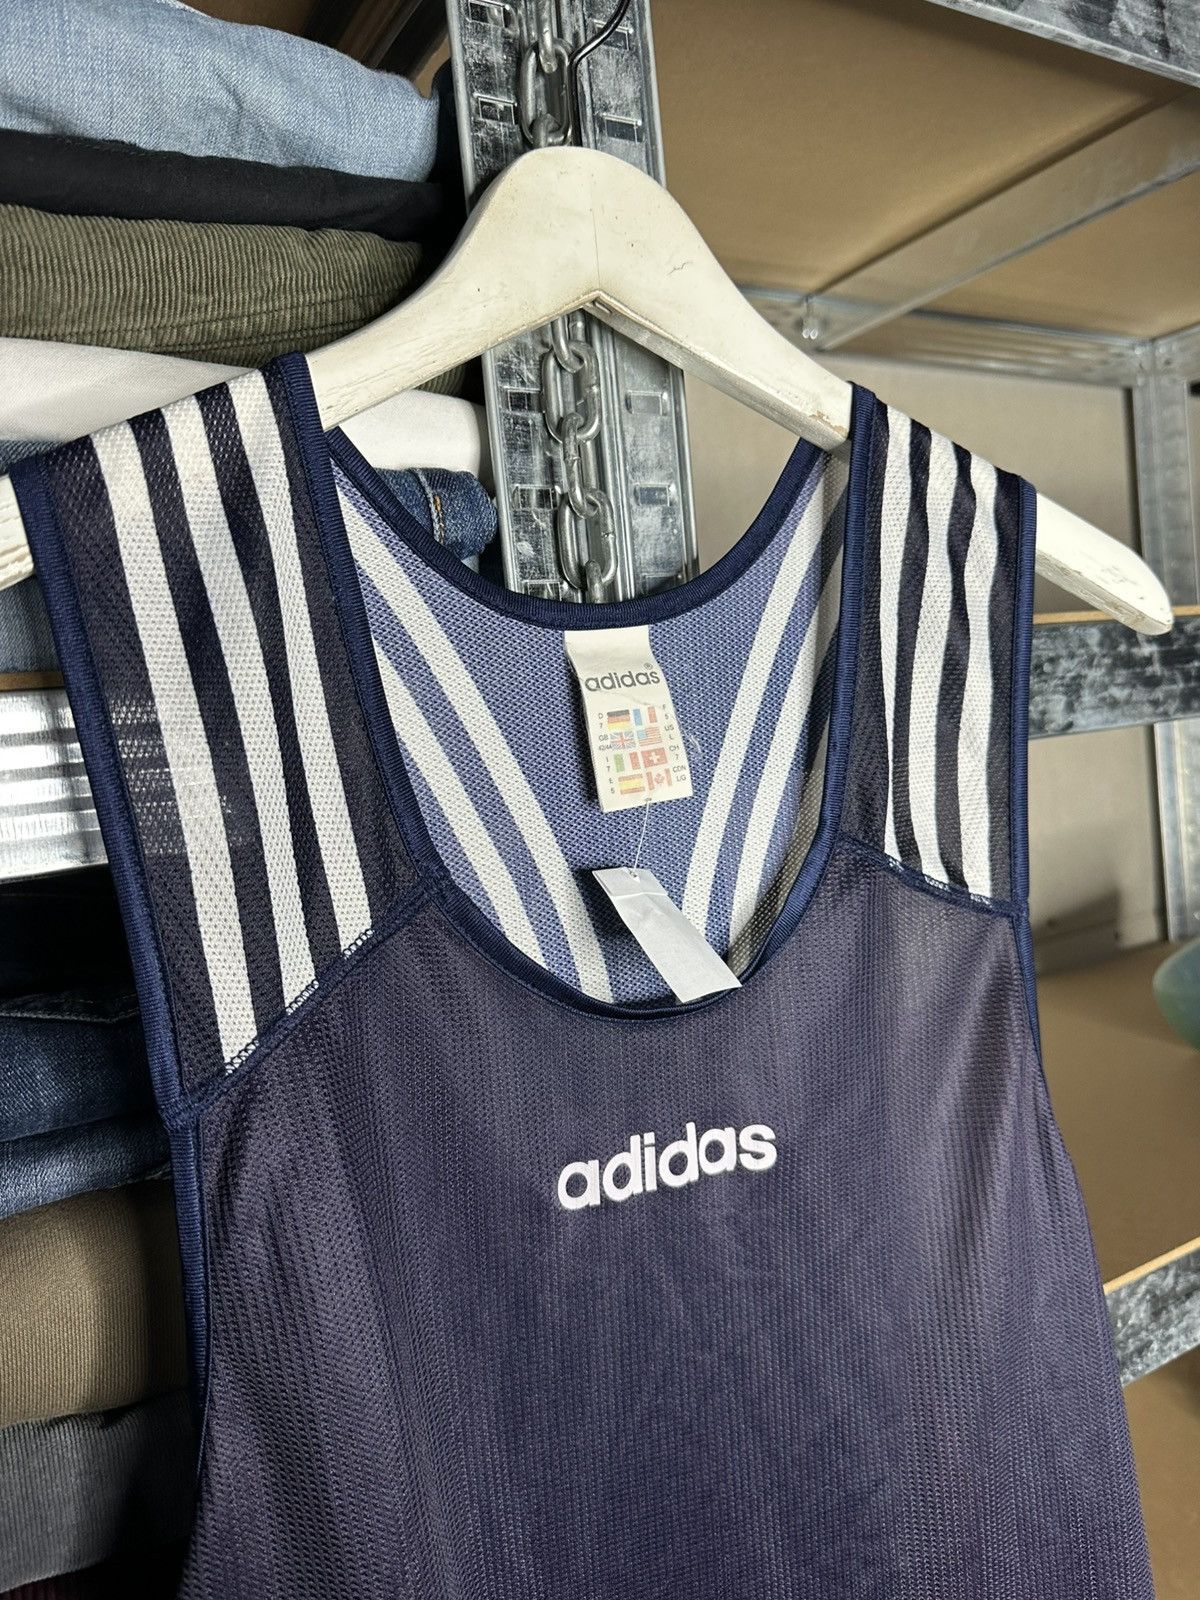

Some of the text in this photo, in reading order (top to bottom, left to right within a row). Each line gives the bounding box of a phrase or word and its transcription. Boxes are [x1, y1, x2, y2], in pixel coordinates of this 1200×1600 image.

[585, 670, 660, 691] adidas
[598, 733, 609, 741] GB
[672, 765, 687, 773] CDN
[676, 774, 687, 782] LG
[557, 1121, 778, 1211] adidas
